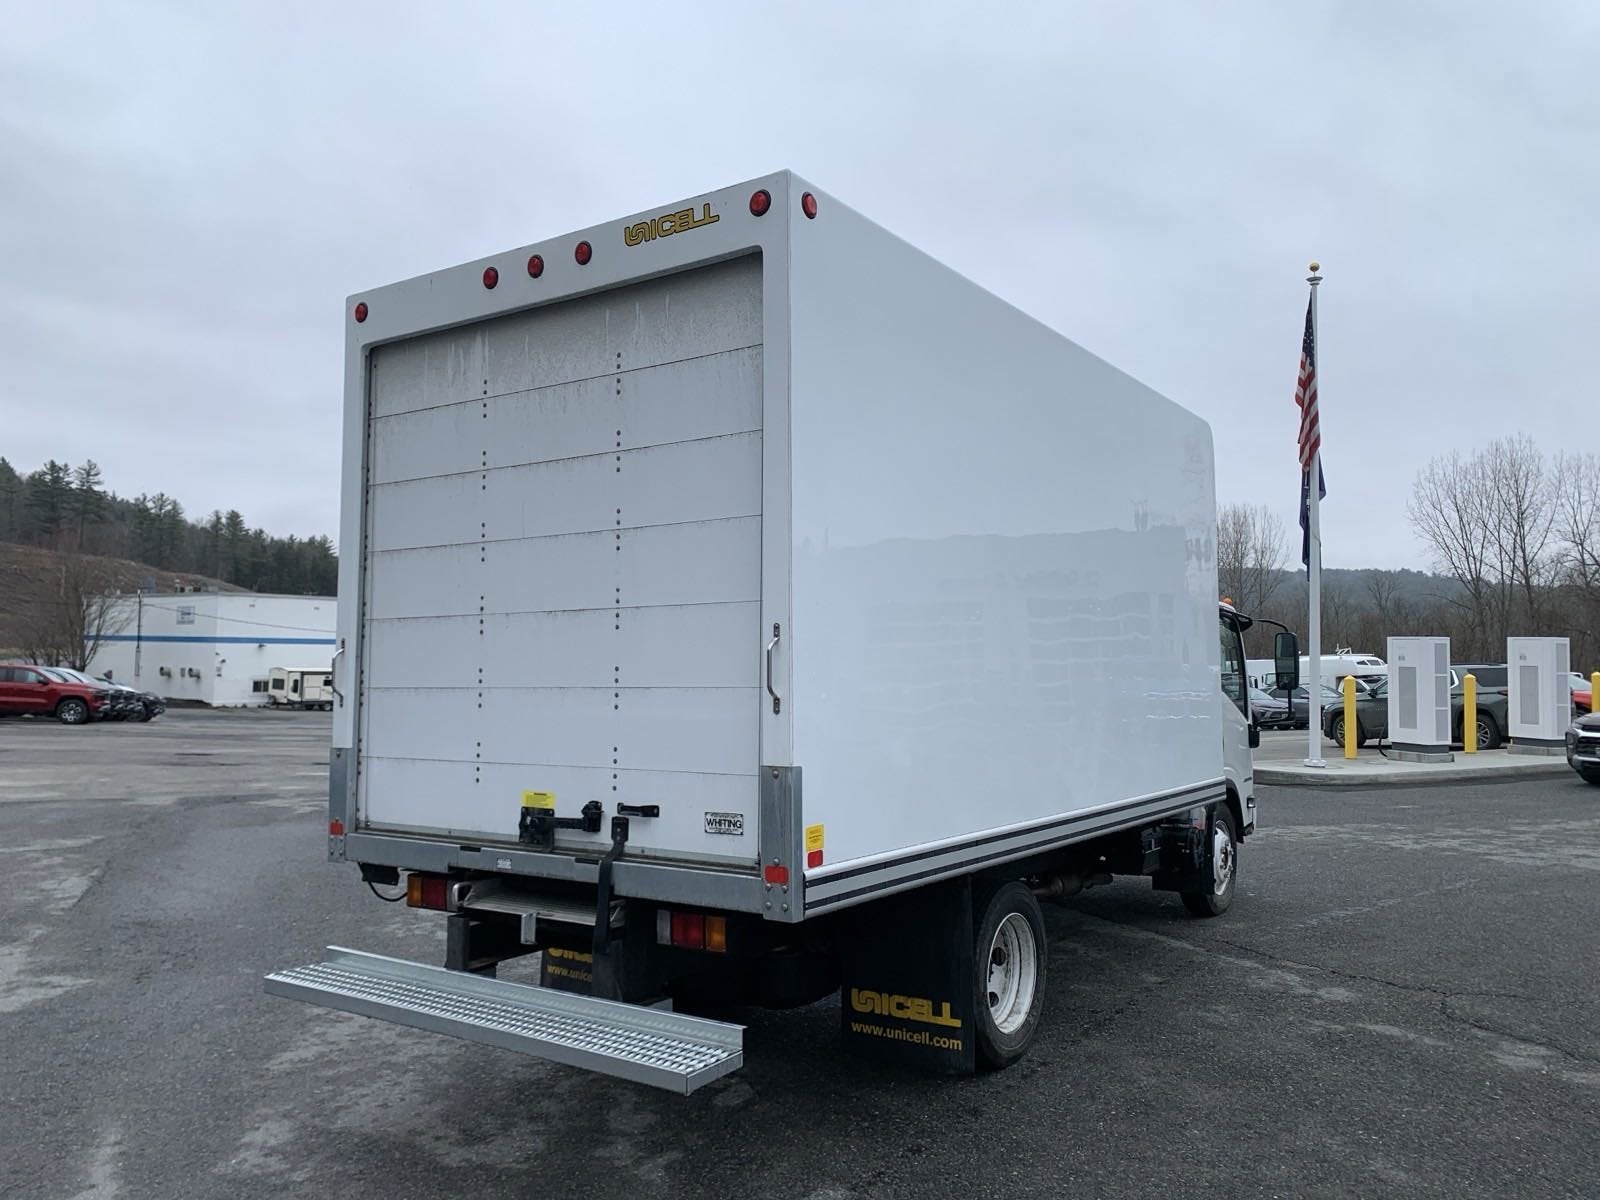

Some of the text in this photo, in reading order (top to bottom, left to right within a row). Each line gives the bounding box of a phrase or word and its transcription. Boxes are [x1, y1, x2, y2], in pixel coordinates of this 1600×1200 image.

[624, 203, 720, 246] UNICELL
[706, 818, 742, 829] WHITING
[851, 988, 961, 1028] UNICELL
[851, 1021, 962, 1051] www.unicell.com
